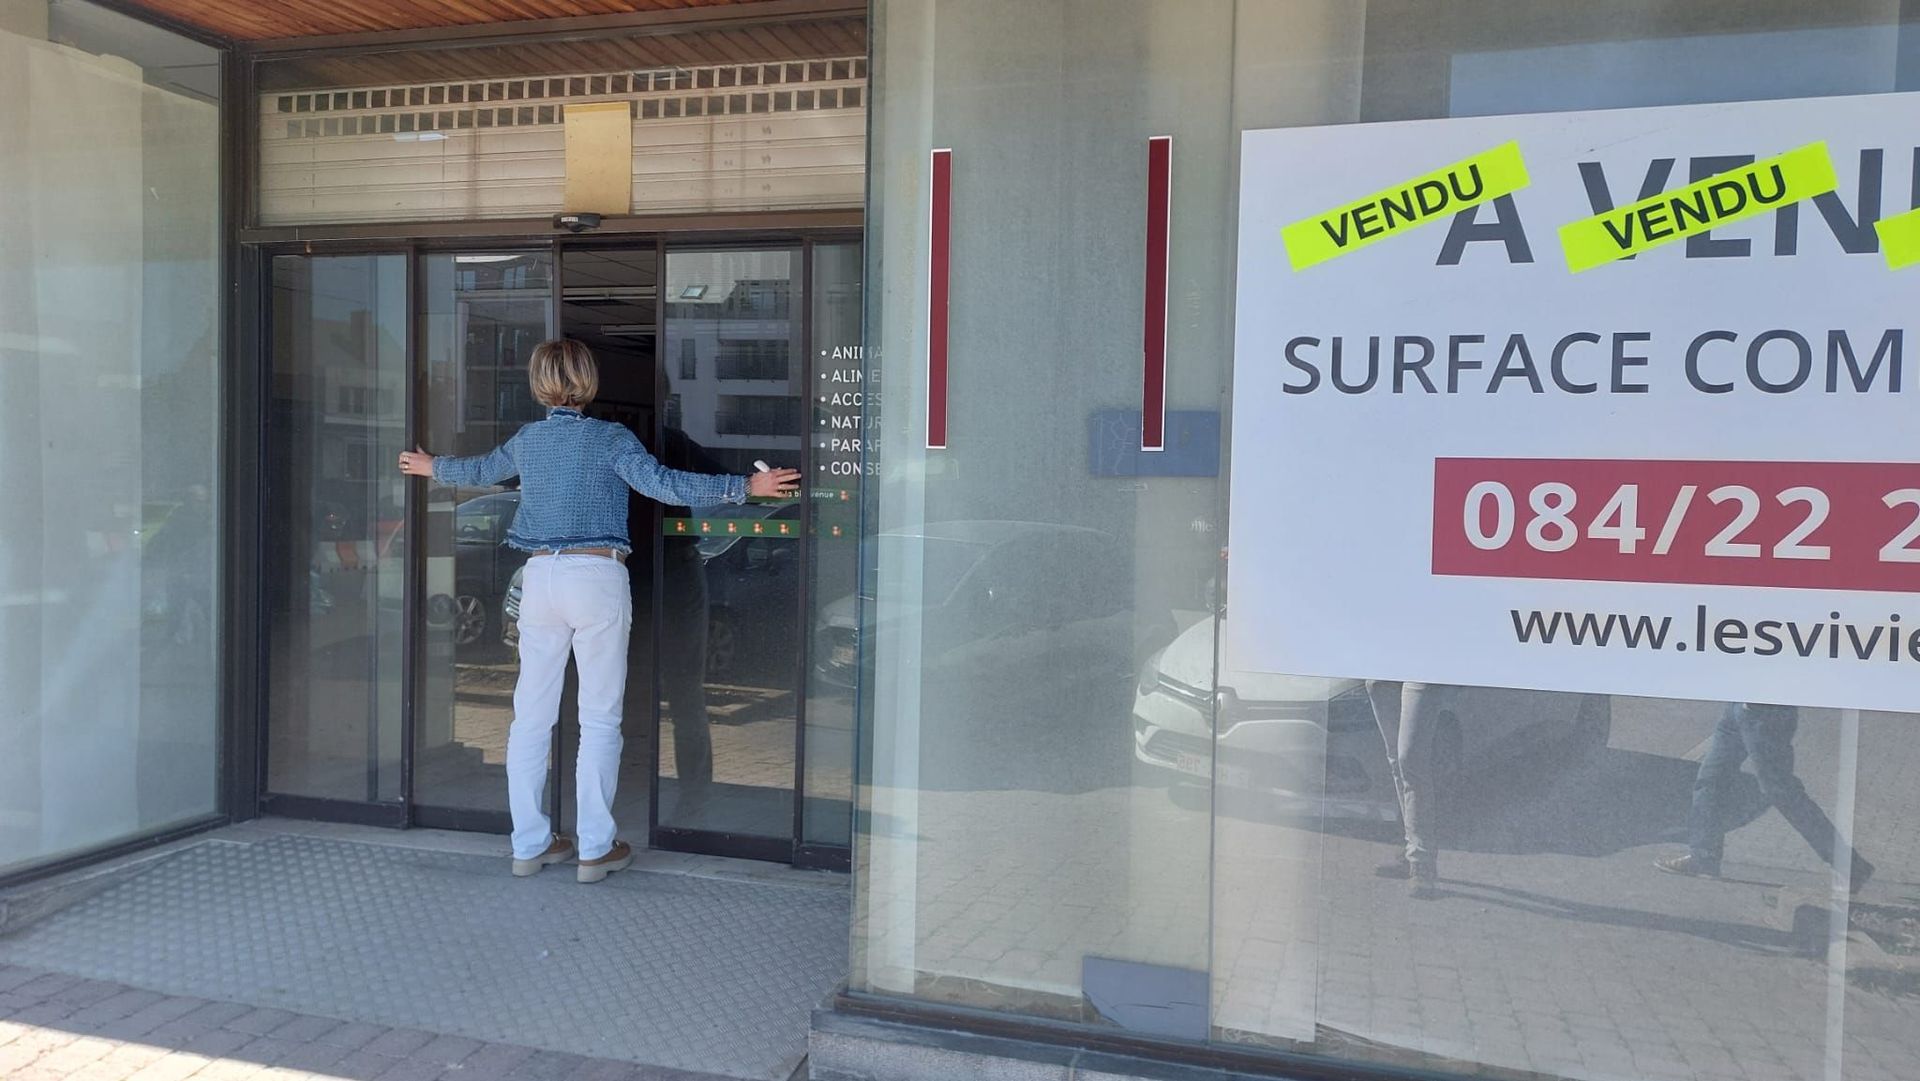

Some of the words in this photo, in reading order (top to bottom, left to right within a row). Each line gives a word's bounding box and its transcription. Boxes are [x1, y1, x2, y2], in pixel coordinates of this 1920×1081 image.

[1320, 164, 1484, 248] VENDU
[1435, 191, 1535, 265] A
[1577, 147, 1920, 260] VEN
[1602, 165, 1787, 250] VENDU
[1282, 331, 1651, 394] SURFACE
[1684, 328, 1904, 393] COM
[1463, 481, 1831, 560] 084/22
[1879, 489, 1920, 562] 2
